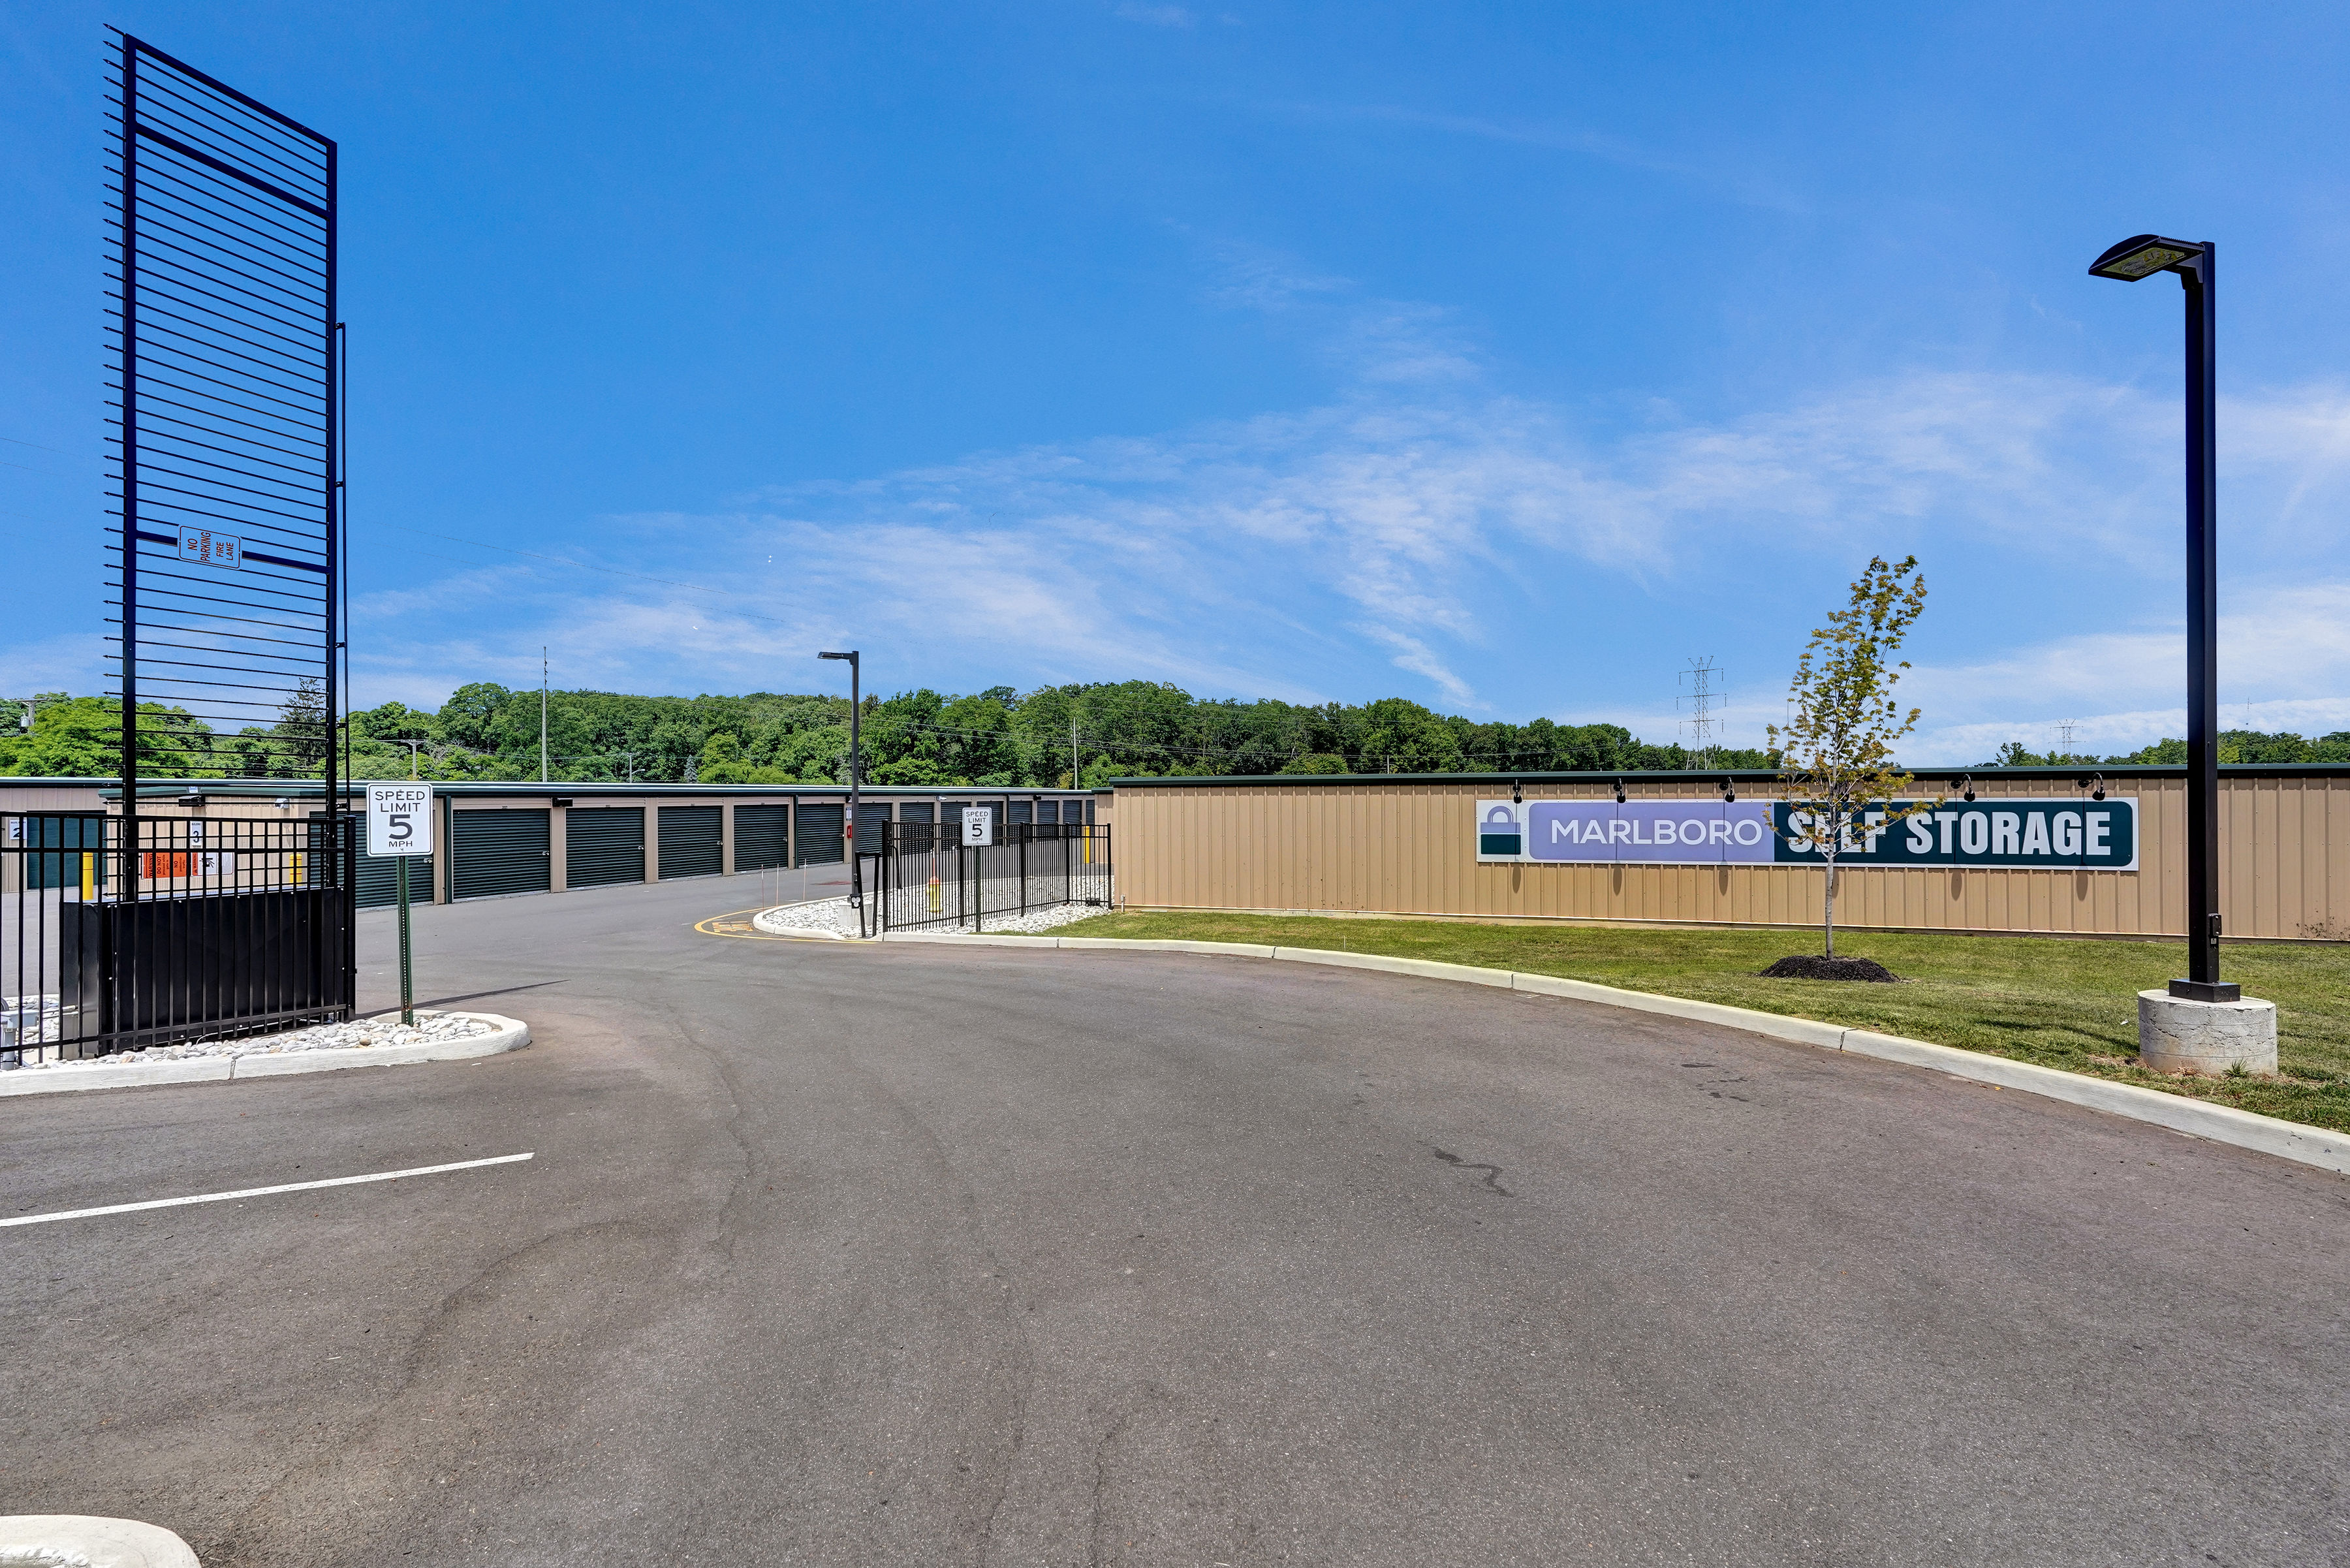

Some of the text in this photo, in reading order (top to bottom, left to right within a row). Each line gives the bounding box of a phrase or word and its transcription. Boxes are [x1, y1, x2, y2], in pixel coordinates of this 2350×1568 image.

[188, 538, 198, 551] NO
[200, 532, 211, 562] PARKING
[375, 791, 425, 800] SPEED
[381, 803, 420, 812] LIMIT
[388, 814, 413, 840] 5
[972, 823, 982, 837] 5
[1551, 819, 1763, 845] MARLBORO
[1905, 811, 2111, 856] STORAGE
[193, 830, 199, 843] 3
